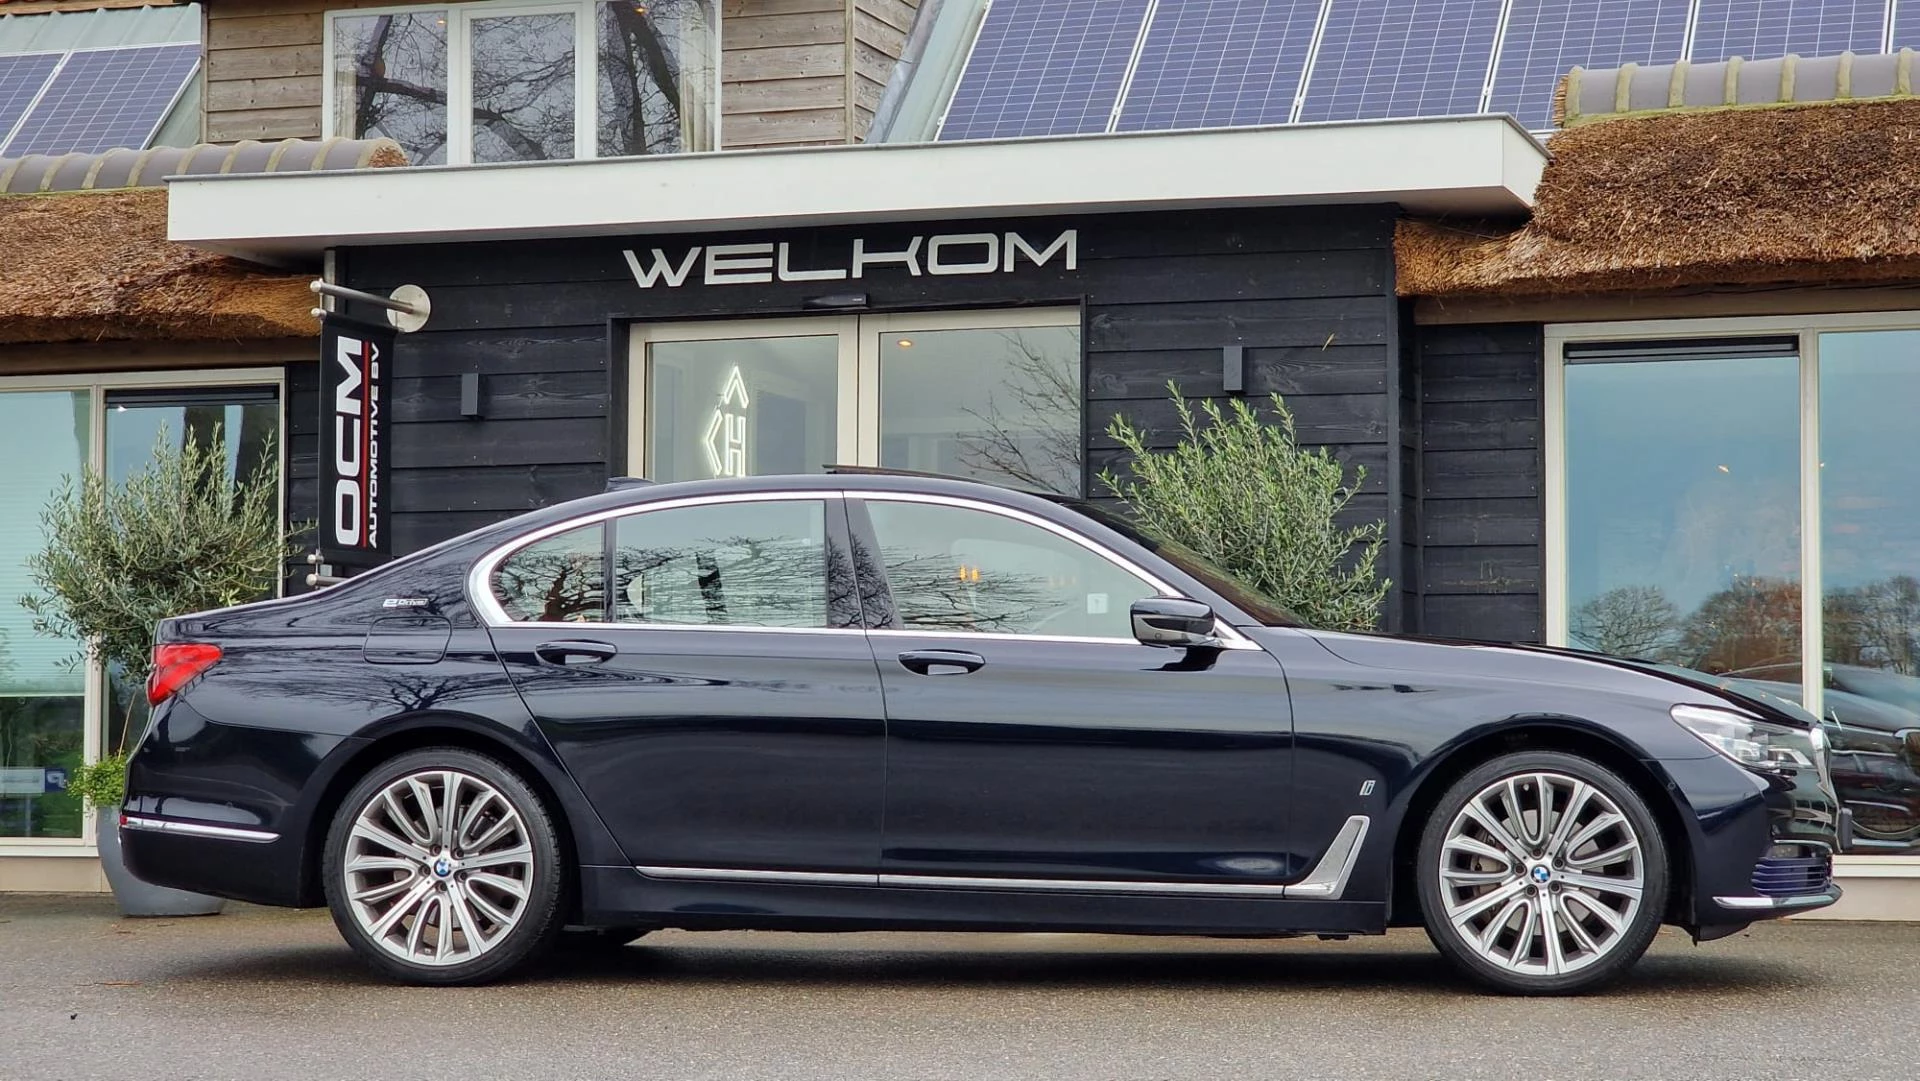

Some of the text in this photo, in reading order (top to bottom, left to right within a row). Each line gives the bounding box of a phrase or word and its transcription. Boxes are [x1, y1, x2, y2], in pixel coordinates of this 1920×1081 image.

[623, 230, 1077, 288] WELKOM
[335, 336, 362, 545] OCM
[368, 342, 380, 549] AUTOMOTIVE BV
